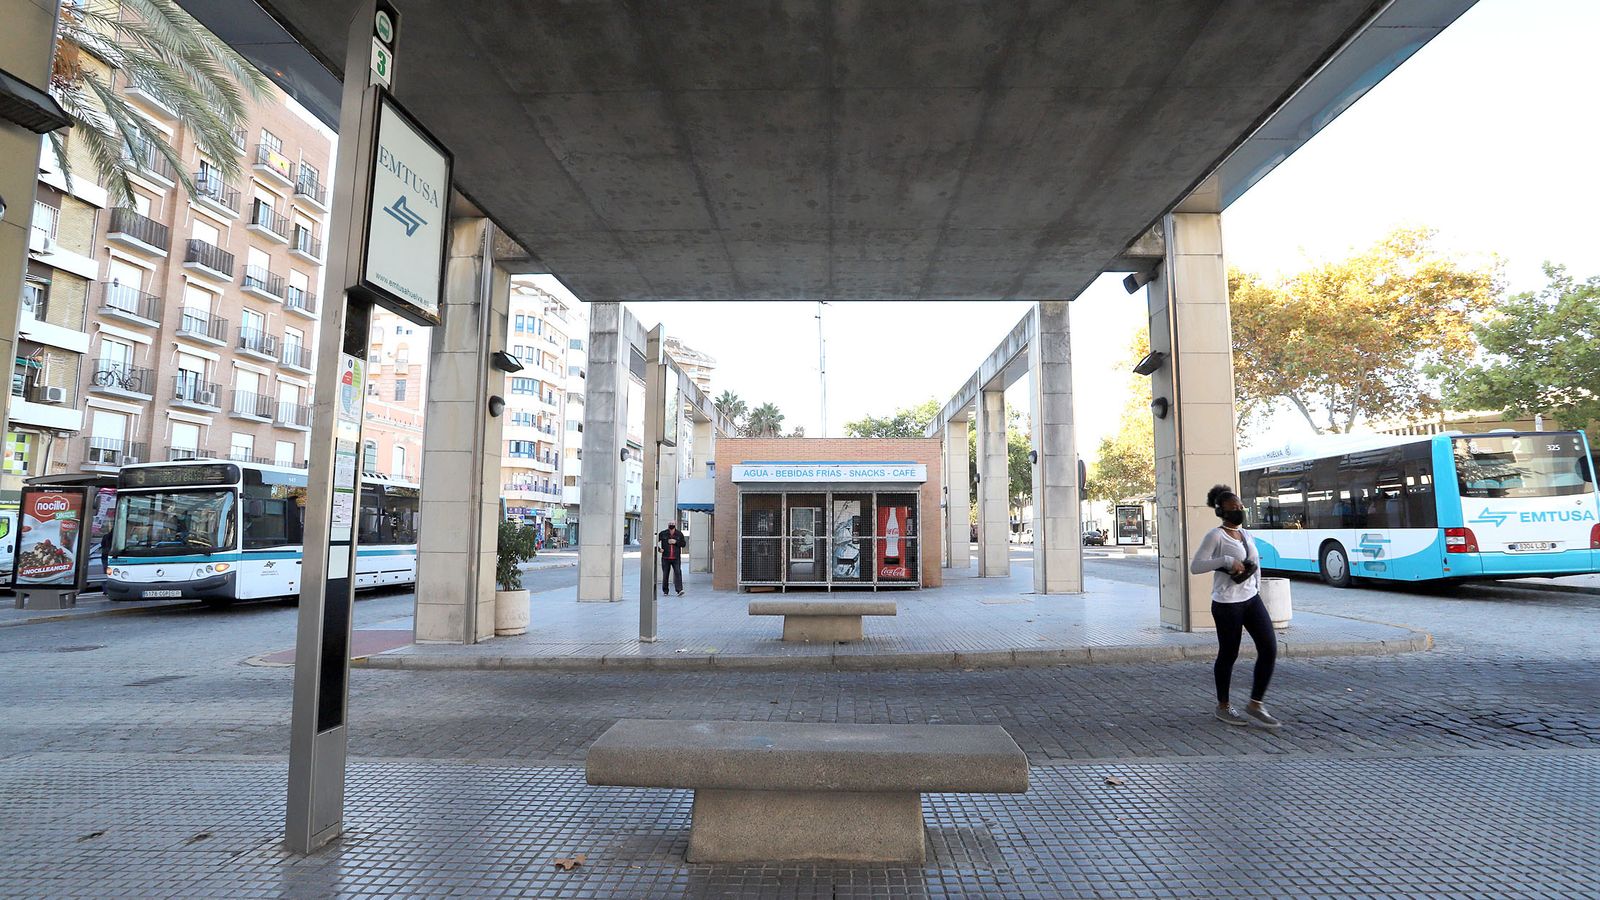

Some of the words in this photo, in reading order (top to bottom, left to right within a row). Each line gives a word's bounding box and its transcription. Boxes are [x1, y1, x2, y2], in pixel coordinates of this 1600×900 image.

[376, 50, 386, 77] 3
[379, 144, 440, 209] EMTUSA
[1511, 439, 1522, 454] 2
[744, 469, 768, 477] AGUA
[776, 469, 814, 477] BEBIDAS
[849, 469, 885, 477] SNACKS
[37, 501, 67, 511] nocilla
[1520, 510, 1595, 523] EMTUSA
